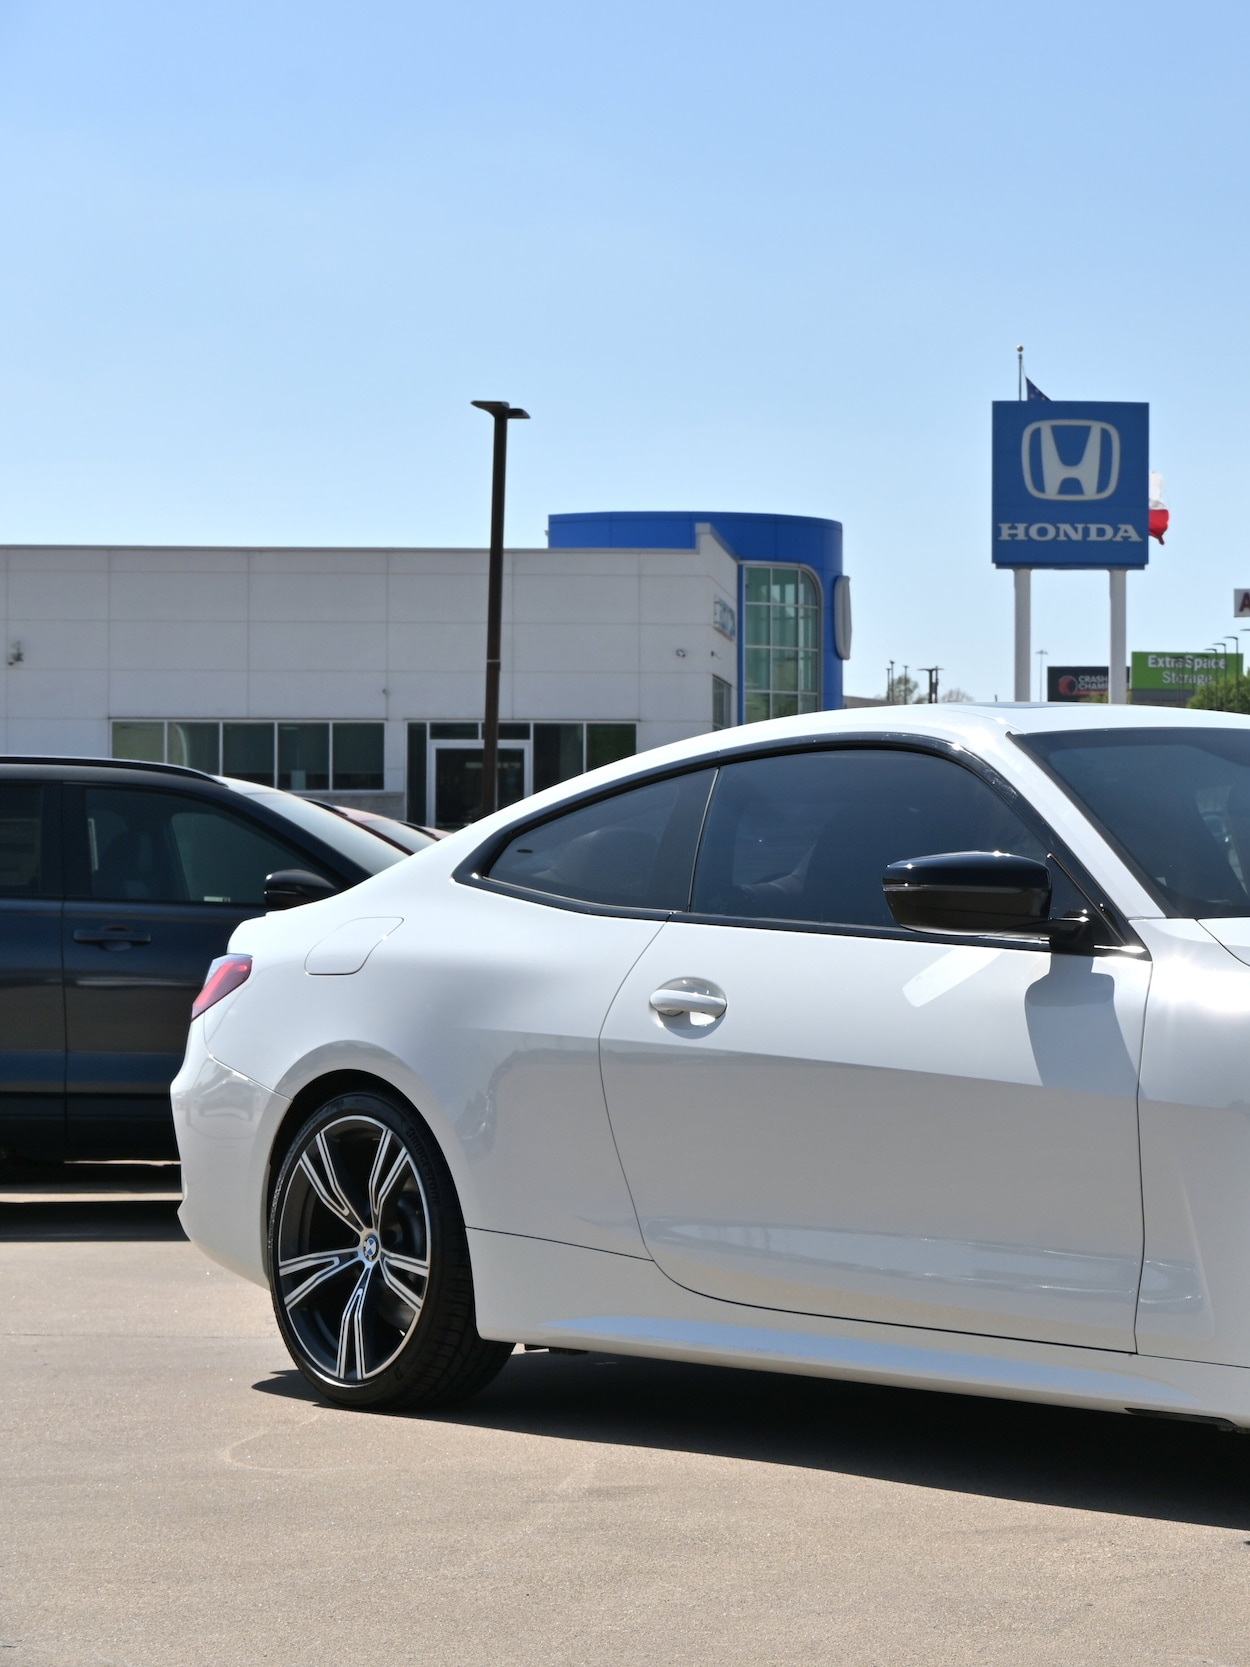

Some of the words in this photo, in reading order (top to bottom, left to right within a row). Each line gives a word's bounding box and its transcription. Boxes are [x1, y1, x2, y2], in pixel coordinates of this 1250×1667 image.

[997, 522, 1143, 542] HONDA
[1148, 655, 1183, 668] Extra
[1185, 655, 1226, 671] Space
[1078, 675, 1109, 683] CRASH
[1162, 671, 1213, 686] Storage
